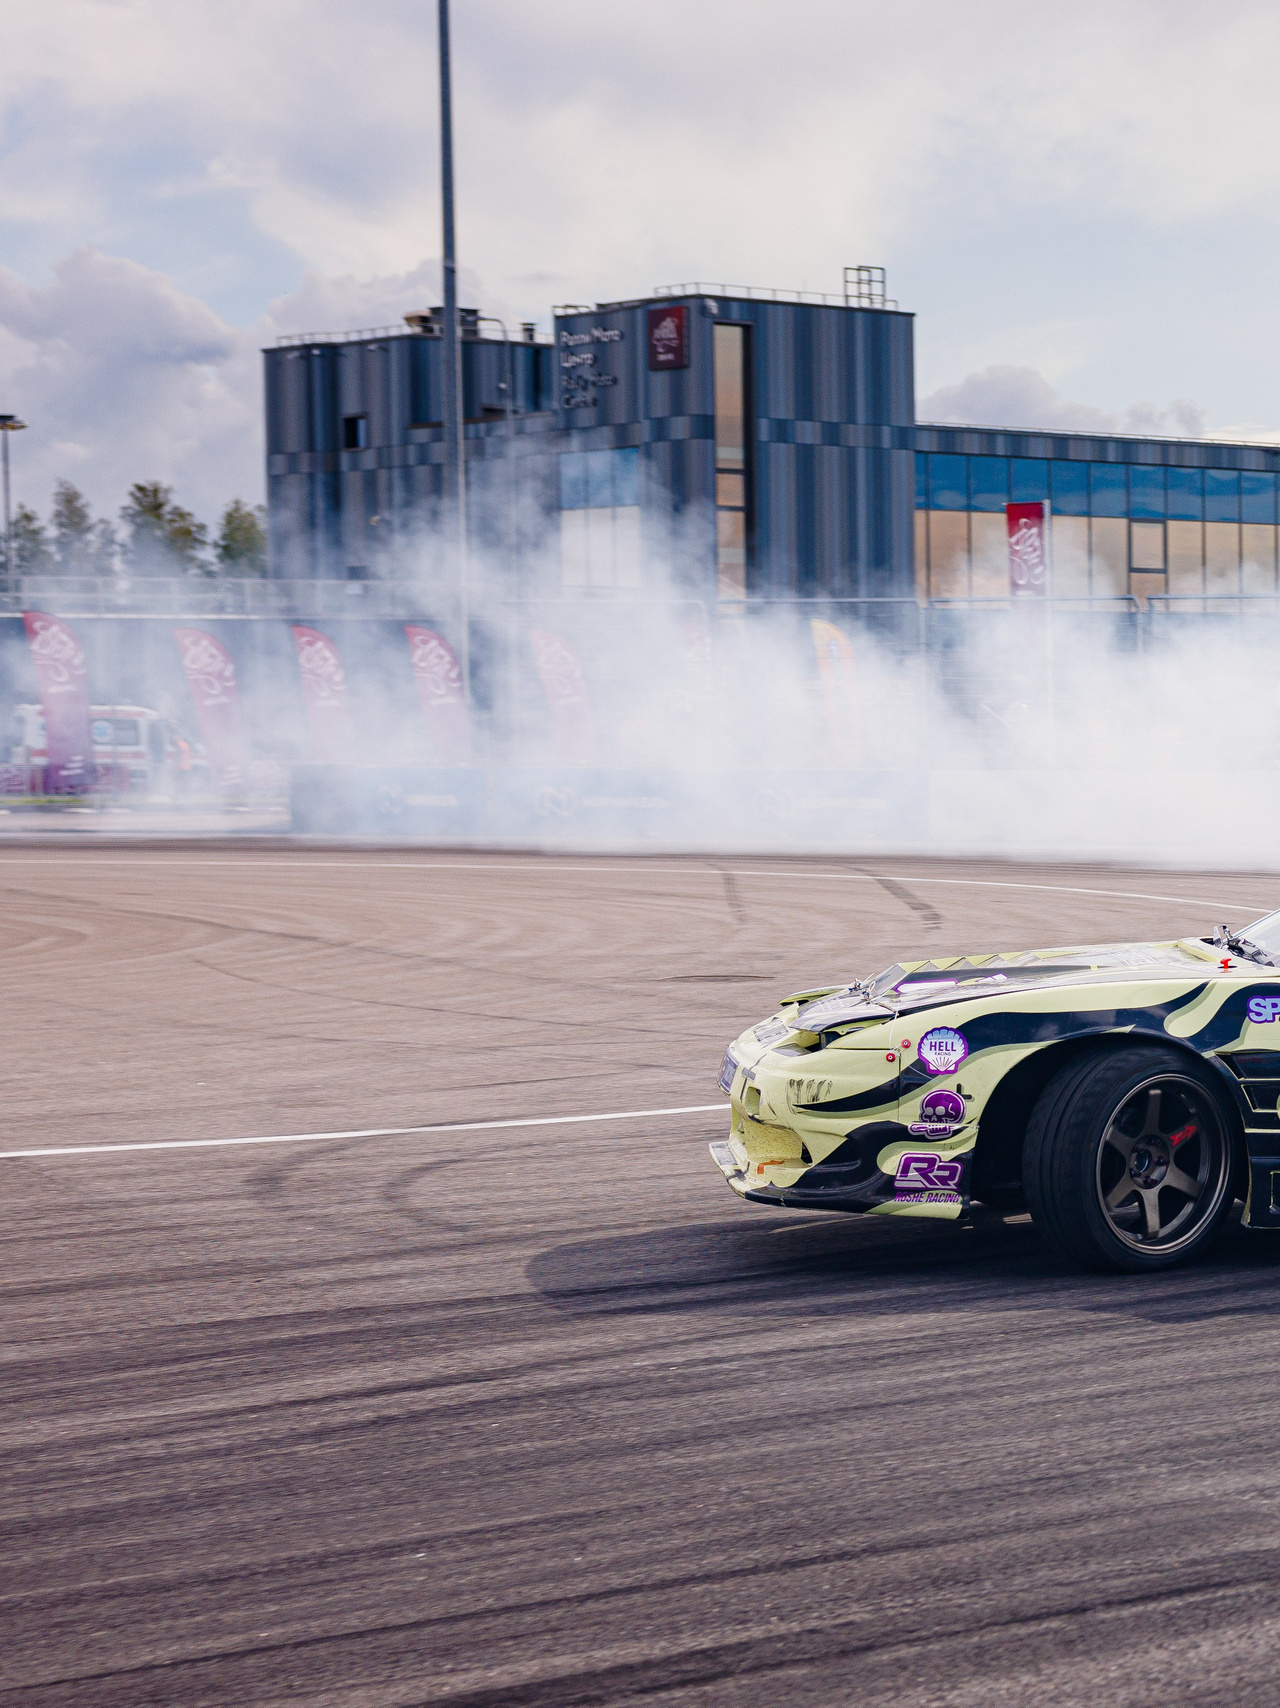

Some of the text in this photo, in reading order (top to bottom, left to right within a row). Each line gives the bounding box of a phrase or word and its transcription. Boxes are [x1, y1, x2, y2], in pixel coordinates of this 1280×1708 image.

[929, 1041, 956, 1052] HELL
[894, 1192, 961, 1203] ROSHE RACING
